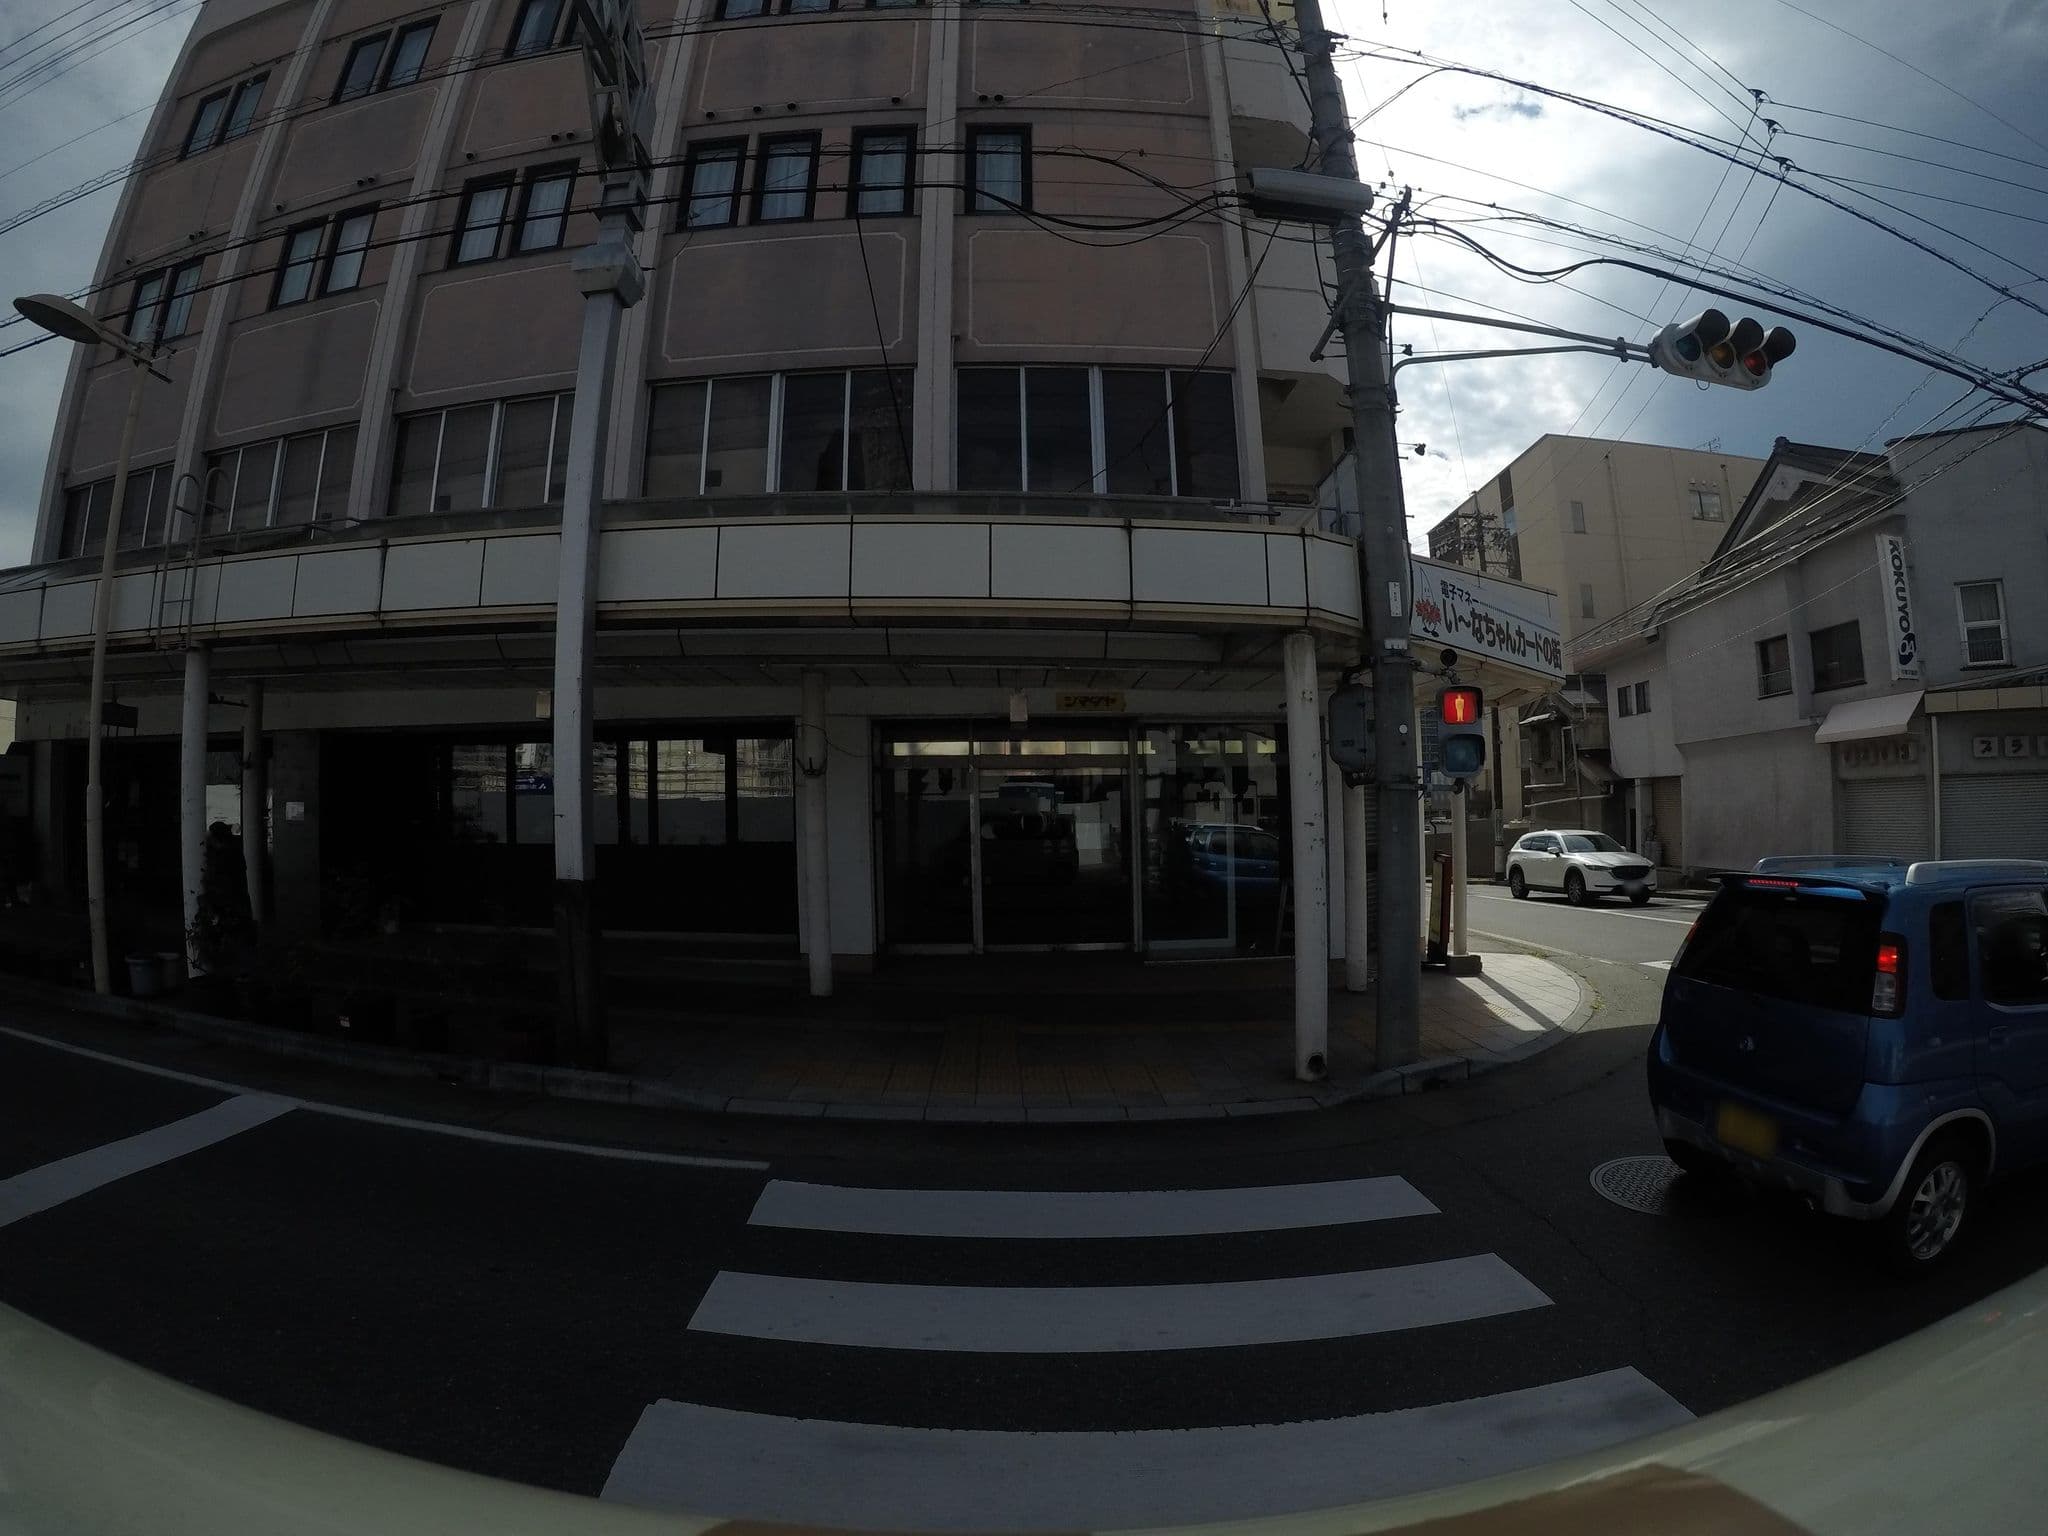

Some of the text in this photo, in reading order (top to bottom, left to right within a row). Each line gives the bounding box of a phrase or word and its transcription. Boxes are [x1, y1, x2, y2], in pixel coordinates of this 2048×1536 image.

[1440, 579, 1480, 607] 電子マネー
[1888, 539, 1911, 634] KOKUYO
